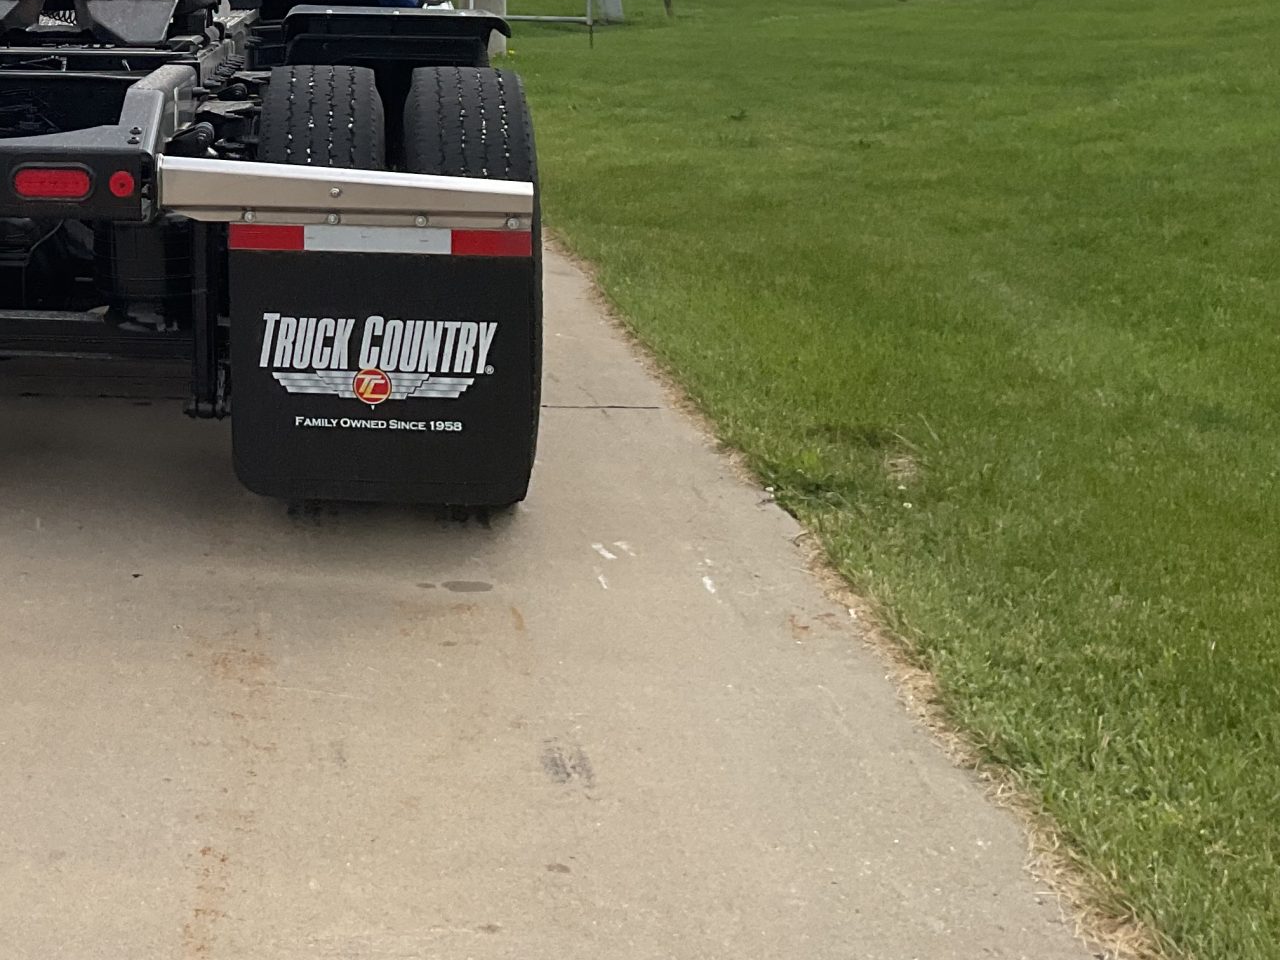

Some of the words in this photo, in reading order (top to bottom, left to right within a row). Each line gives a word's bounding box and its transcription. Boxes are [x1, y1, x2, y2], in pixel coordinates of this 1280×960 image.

[259, 312, 356, 370] TRUCK
[358, 315, 498, 374] COUNTRY
[295, 416, 338, 427] FAMILY
[340, 418, 387, 429] OWNED
[389, 419, 426, 431] SINCE
[429, 421, 463, 432] 1958
